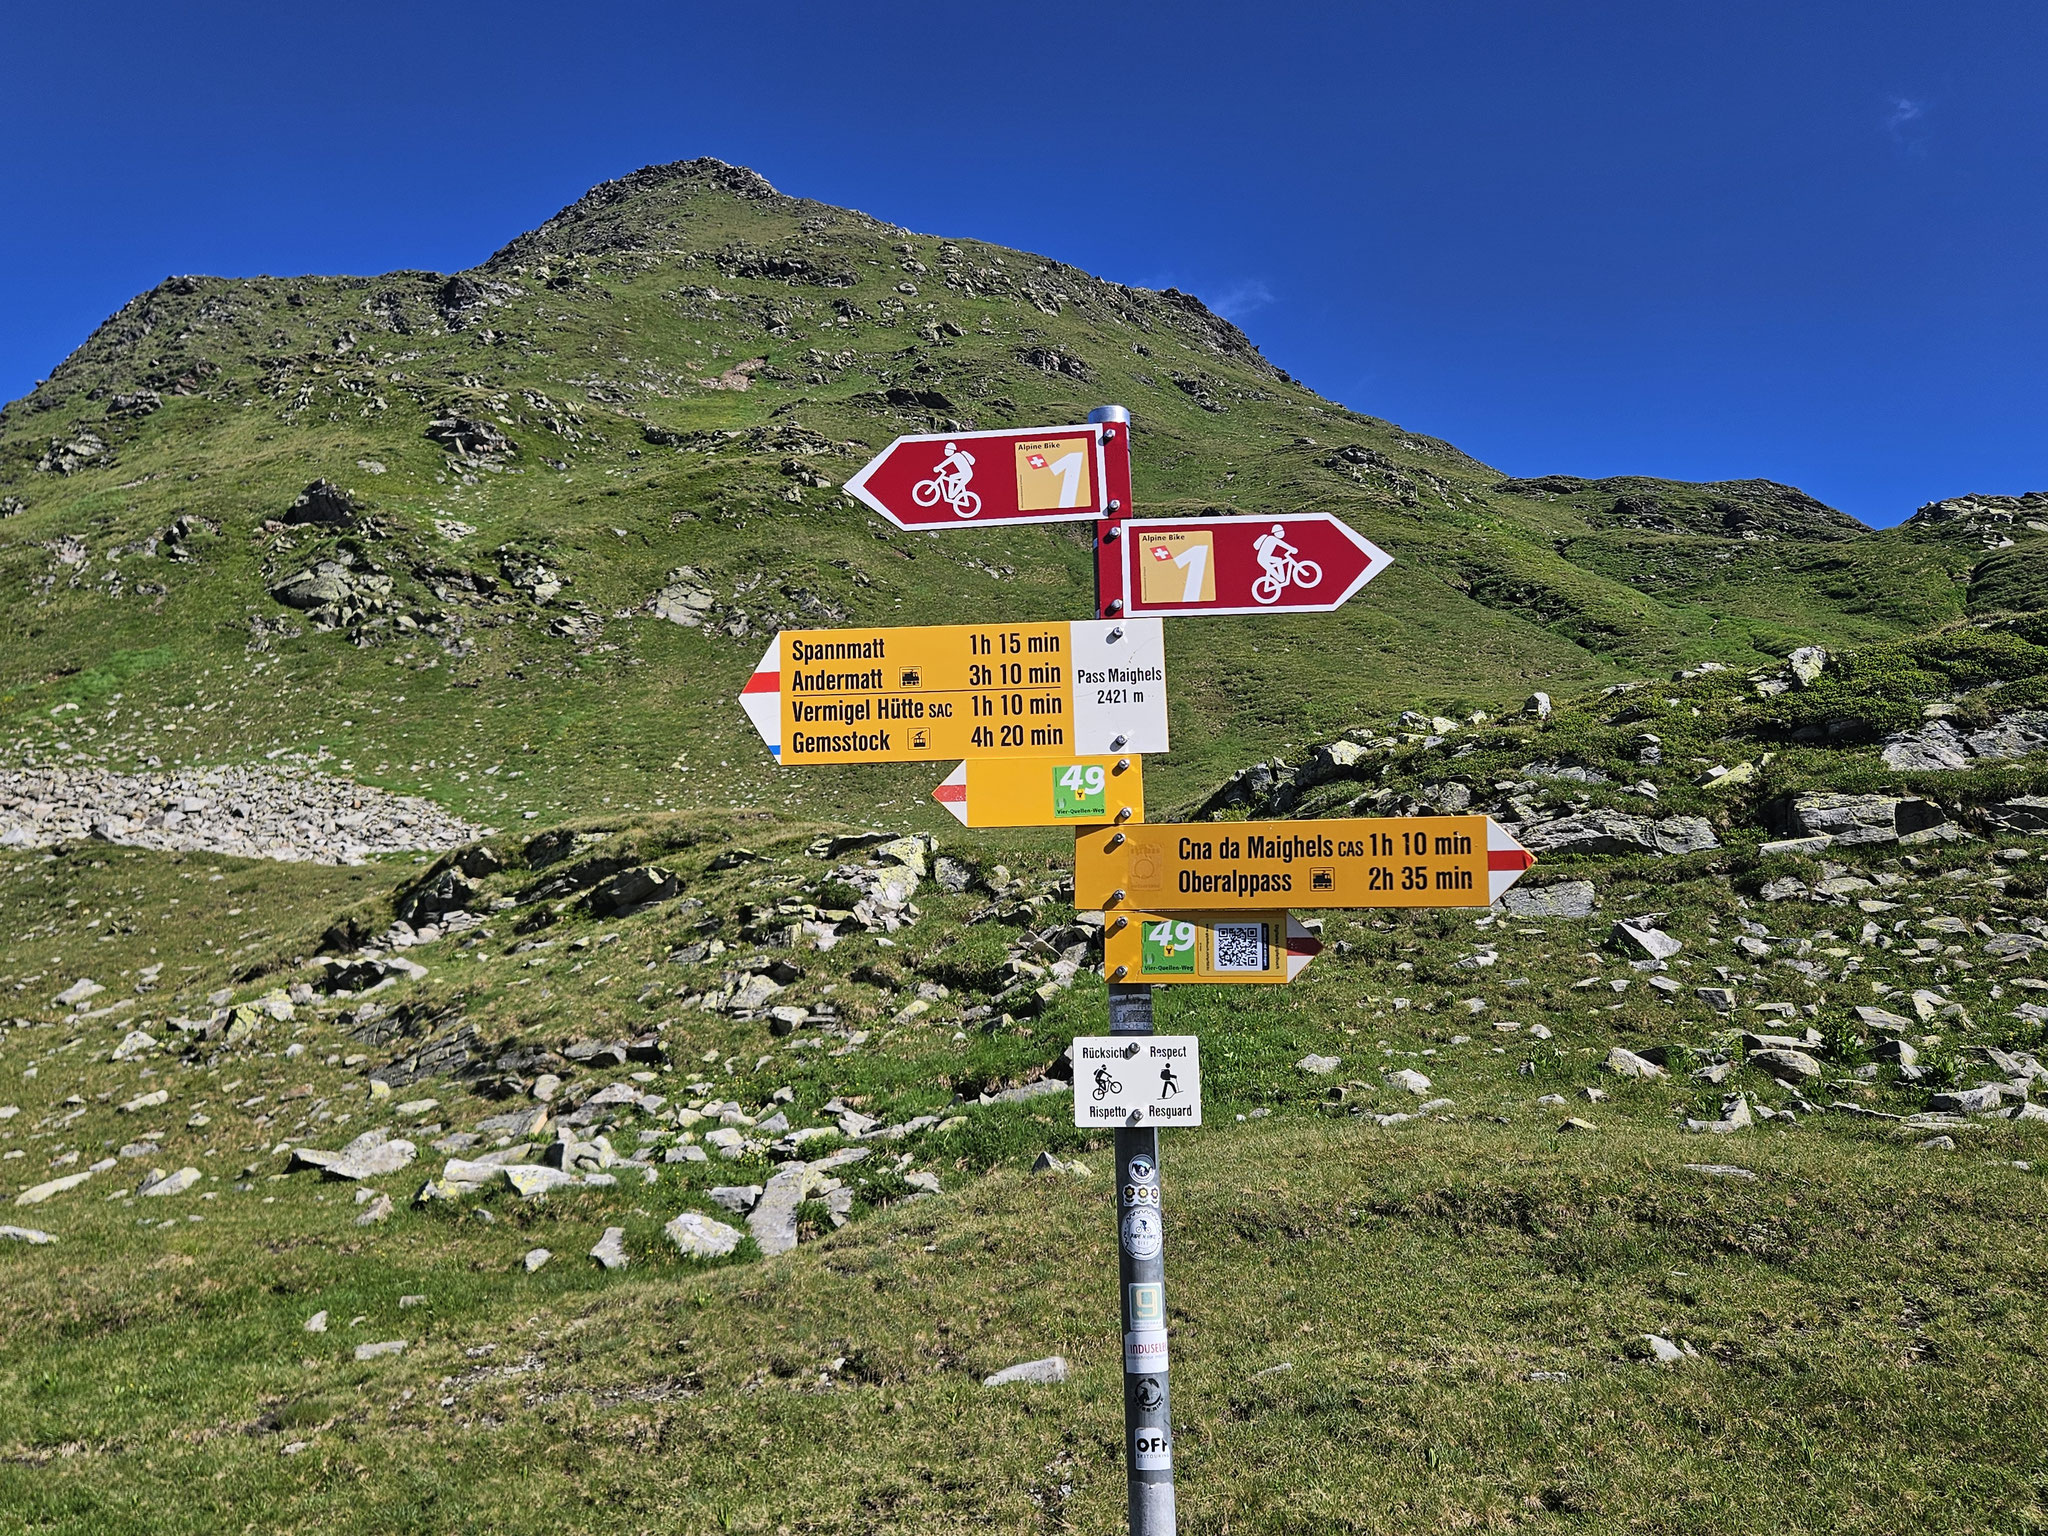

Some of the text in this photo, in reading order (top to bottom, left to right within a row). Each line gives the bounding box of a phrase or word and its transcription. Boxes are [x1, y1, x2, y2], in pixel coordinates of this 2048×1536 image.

[1018, 443, 1042, 452] Alpine
[1049, 452, 1084, 508] 1
[1142, 533, 1185, 542] Alpine Bike
[1173, 545, 1209, 602] 1
[792, 632, 1060, 665] Spannmatt 1h 15 min
[791, 662, 1061, 691] Andermatt 3h 10 min
[1077, 667, 1162, 685] Pass Maighels
[792, 693, 1062, 725] Vermigel Hütte SAC 1h 10 min
[1097, 689, 1144, 704] 2421 m
[792, 724, 1063, 753] Gemsstock 4h 20 min
[1059, 765, 1106, 795] 49
[1178, 837, 1212, 860] Cna
[1219, 836, 1240, 859] da
[1247, 834, 1333, 863] Maighels
[1338, 841, 1364, 857] CAS
[1369, 833, 1393, 856] 1h
[1402, 832, 1427, 856] 10
[1435, 831, 1471, 855] min
[1178, 865, 1472, 898] Oberalppass 2h 35 min
[1148, 920, 1196, 952] 49
[1082, 1047, 1129, 1059] Rücksicht
[1150, 1046, 1187, 1060] Respect
[1089, 1106, 1127, 1120] Rispetto
[1148, 1105, 1192, 1119] Resguard
